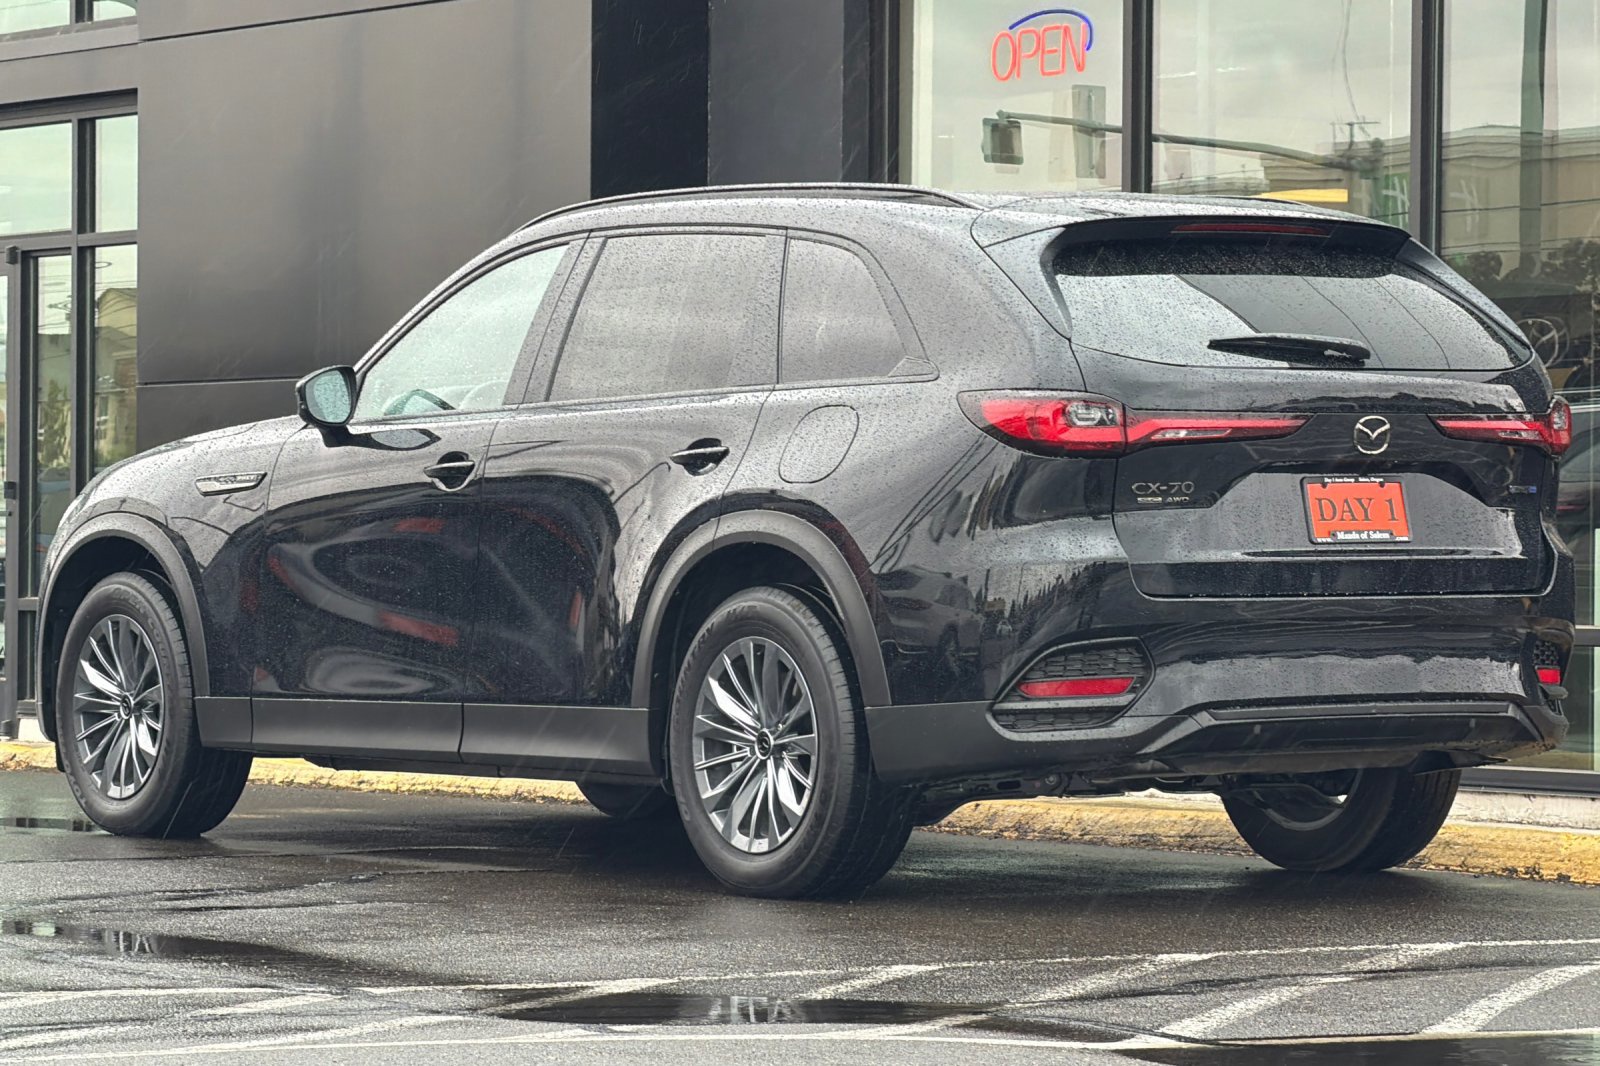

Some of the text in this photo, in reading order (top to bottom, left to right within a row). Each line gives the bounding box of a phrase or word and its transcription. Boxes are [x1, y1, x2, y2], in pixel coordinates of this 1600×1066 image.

[991, 23, 1087, 82] OPEN
[1131, 481, 1194, 495] CX-70
[1315, 497, 1399, 522] DAY 1
[1336, 531, 1360, 539] Mazda
[1360, 531, 1368, 539] of
[1369, 530, 1390, 539] Salem
